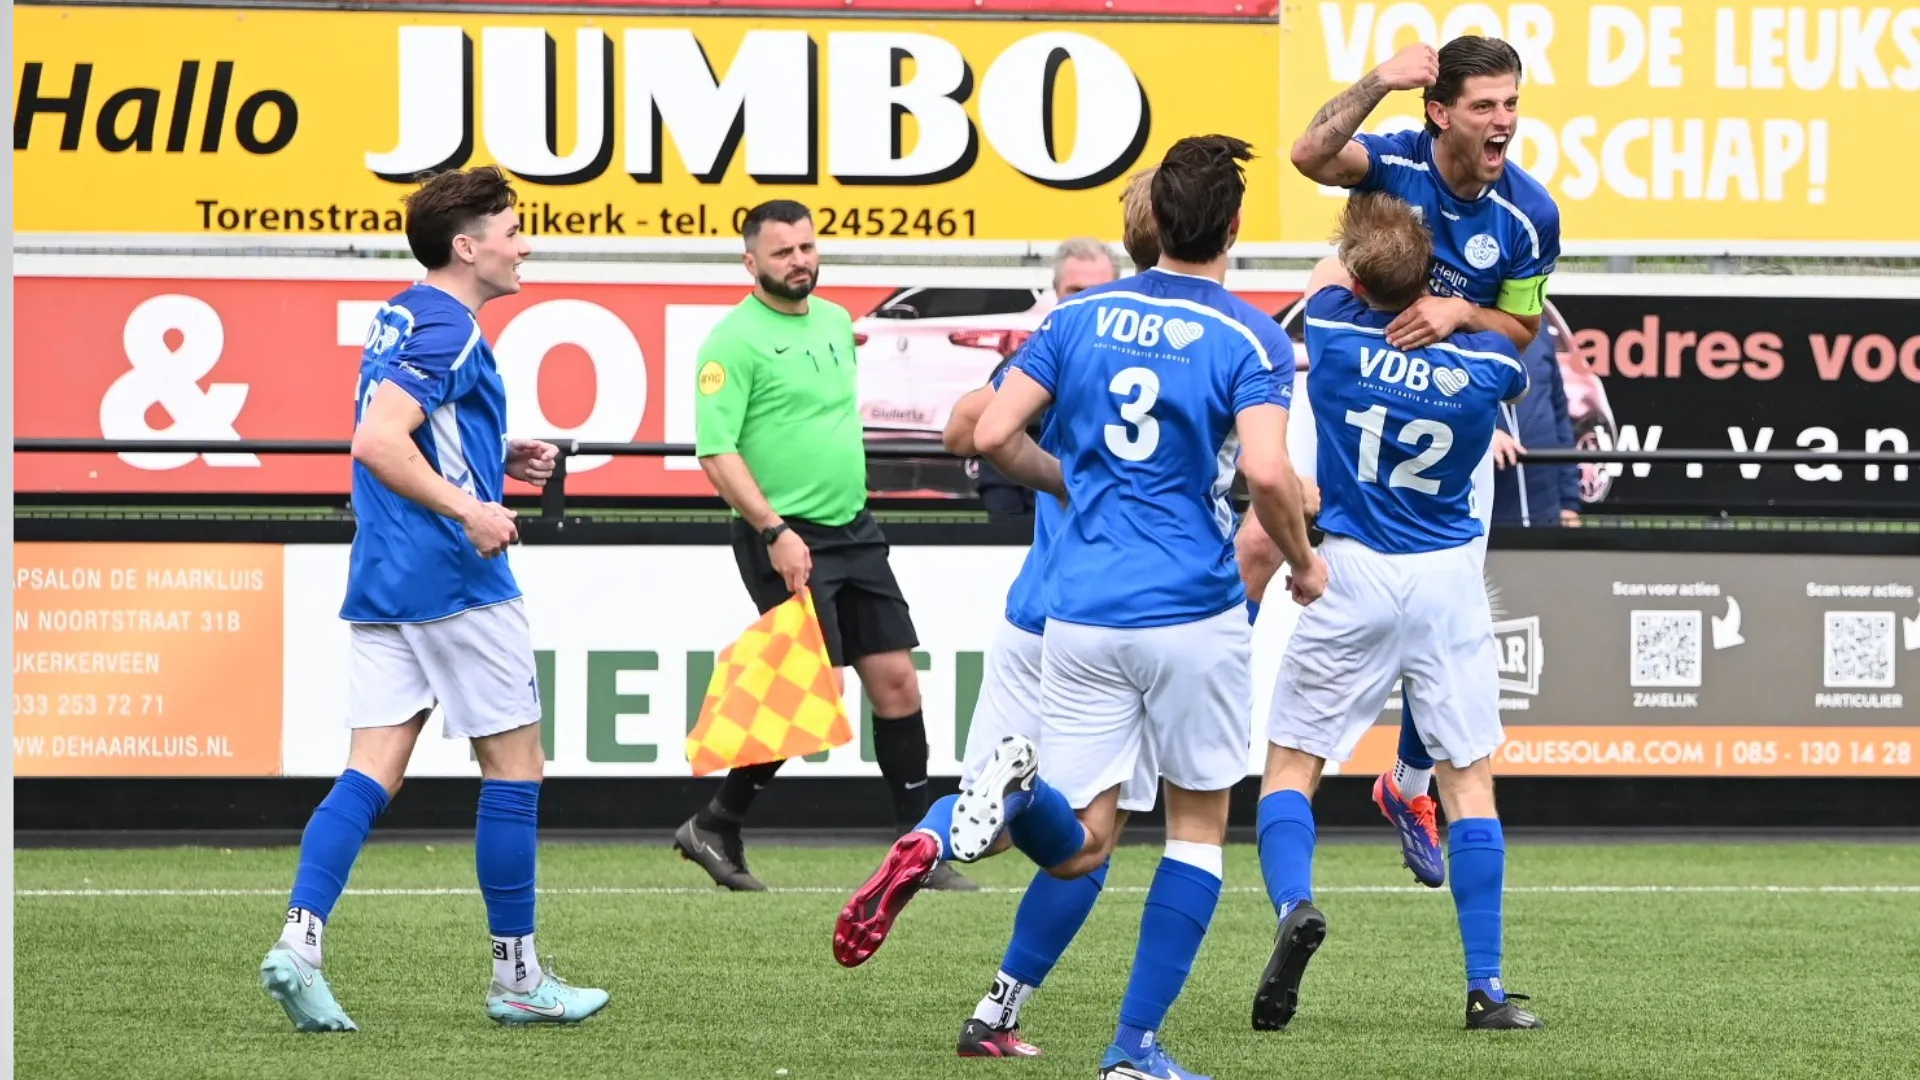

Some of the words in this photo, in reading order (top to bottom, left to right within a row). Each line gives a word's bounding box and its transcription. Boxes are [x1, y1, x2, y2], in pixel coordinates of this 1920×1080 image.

[1586, 5, 1683, 89] DE
[13, 60, 299, 155] Hallo
[364, 25, 1151, 191] JUMBO
[1318, 114, 1829, 205] DSCHAP!
[519, 203, 626, 236] ijkerk
[660, 204, 718, 236] tel.
[1096, 306, 1164, 347] VDB
[1572, 315, 1785, 380] adres
[99, 294, 262, 470] &
[1360, 346, 1431, 391] VDB
[1103, 366, 1161, 461] 3
[1344, 404, 1454, 495] 12
[13, 567, 101, 591] PSALON
[111, 568, 137, 591] DE
[147, 568, 264, 591] HAARKLUIS
[1612, 581, 1646, 596] Scan
[1648, 584, 1677, 596] voor
[1679, 581, 1720, 596] acties
[1806, 582, 1839, 597] Scan
[1841, 585, 1870, 597] voor
[1873, 582, 1914, 597] acties
[38, 609, 192, 632] NOORTSTRAAT
[200, 611, 240, 632] 31B
[57, 694, 97, 716] 253
[106, 694, 132, 717] 72
[141, 695, 164, 717] 71
[1633, 693, 1698, 707] ZAKELIJK
[1815, 693, 1903, 708] PARTICULIER
[1492, 739, 1704, 765] .QUESOLAR.COM
[1732, 739, 1777, 765] 085
[1800, 740, 1841, 765] 130
[1850, 741, 1875, 765] 14
[1883, 741, 1912, 766] 28
